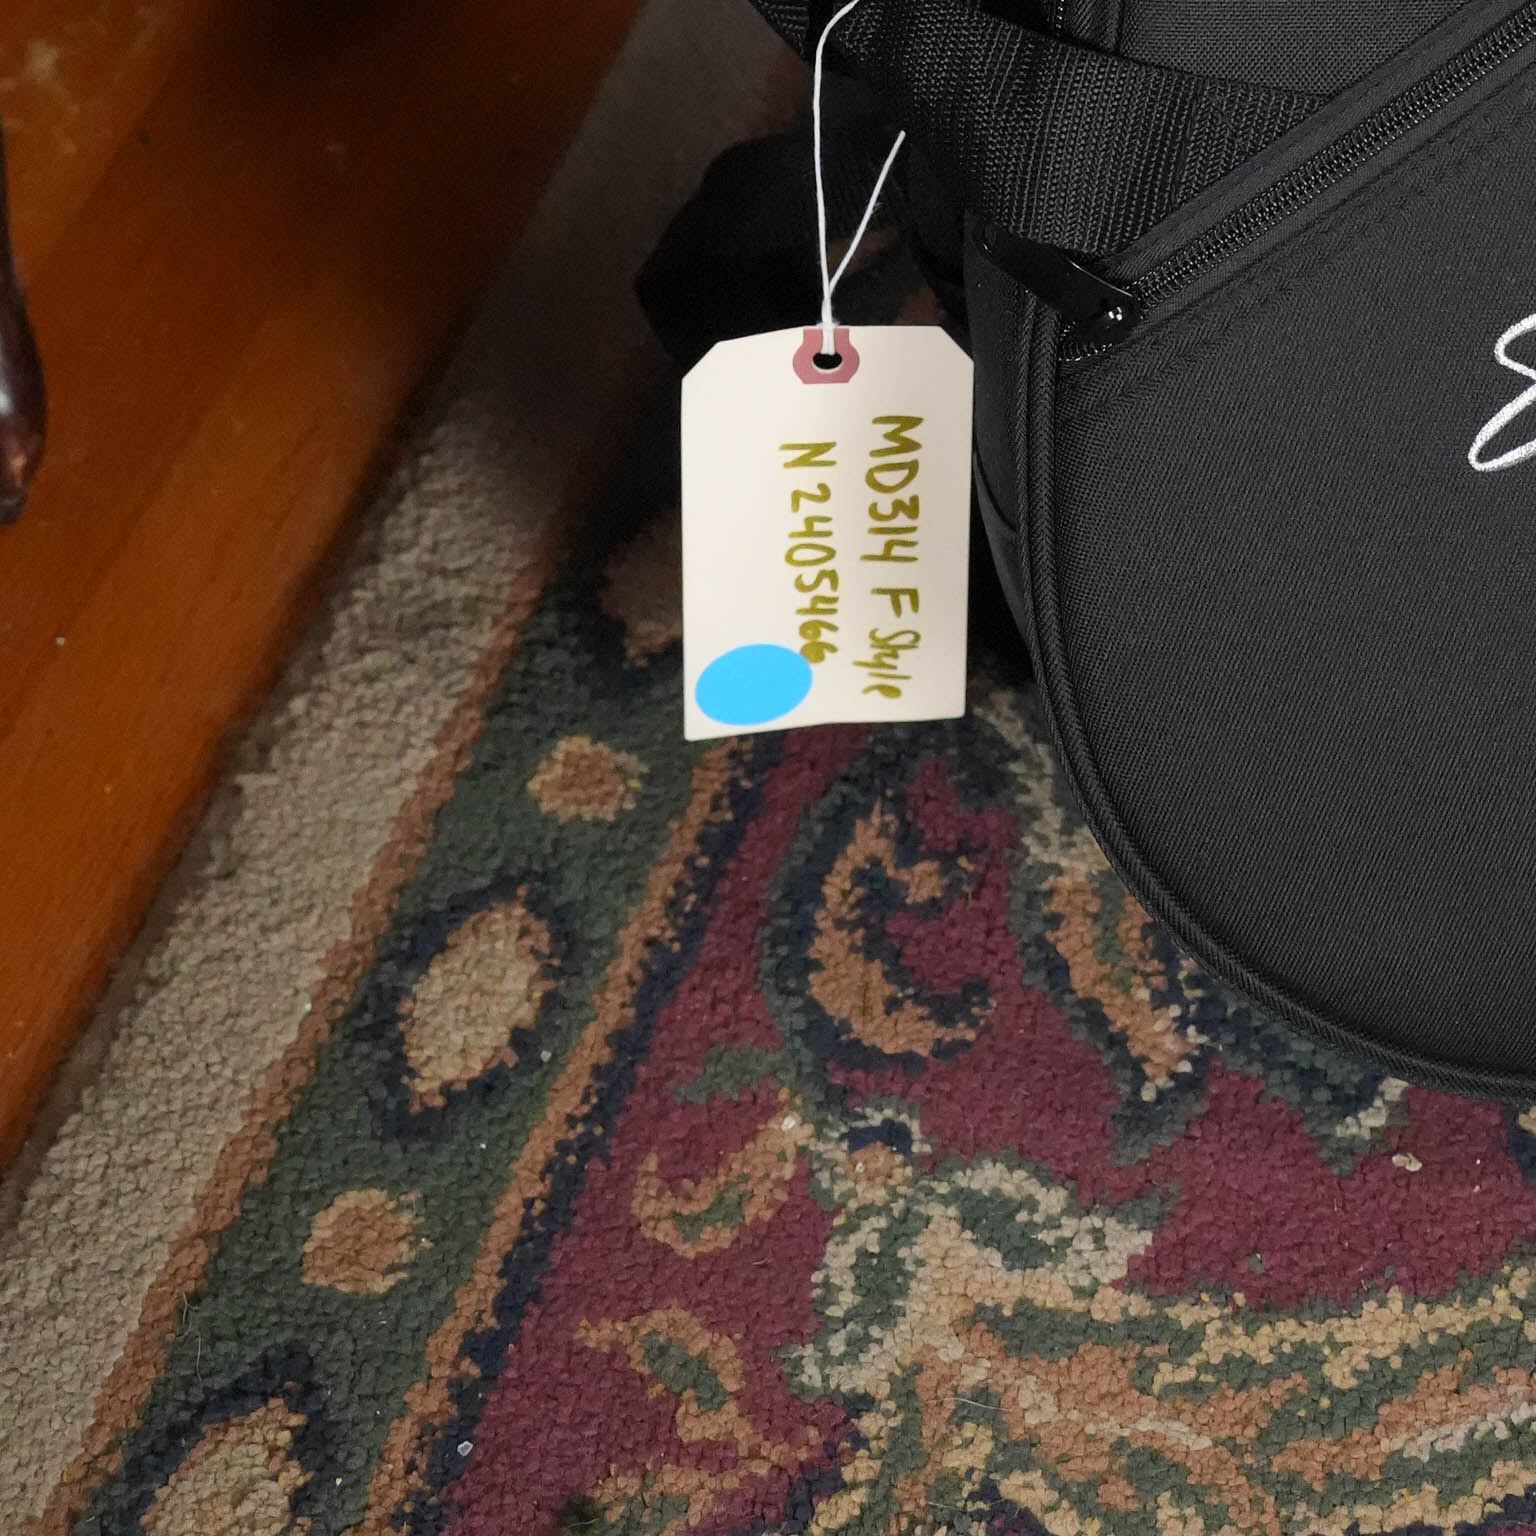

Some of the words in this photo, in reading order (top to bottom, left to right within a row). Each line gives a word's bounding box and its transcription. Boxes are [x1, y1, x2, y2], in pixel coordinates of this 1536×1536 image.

[860, 416, 922, 562] MD314
[872, 588, 919, 616] F
[853, 628, 921, 698] Style
